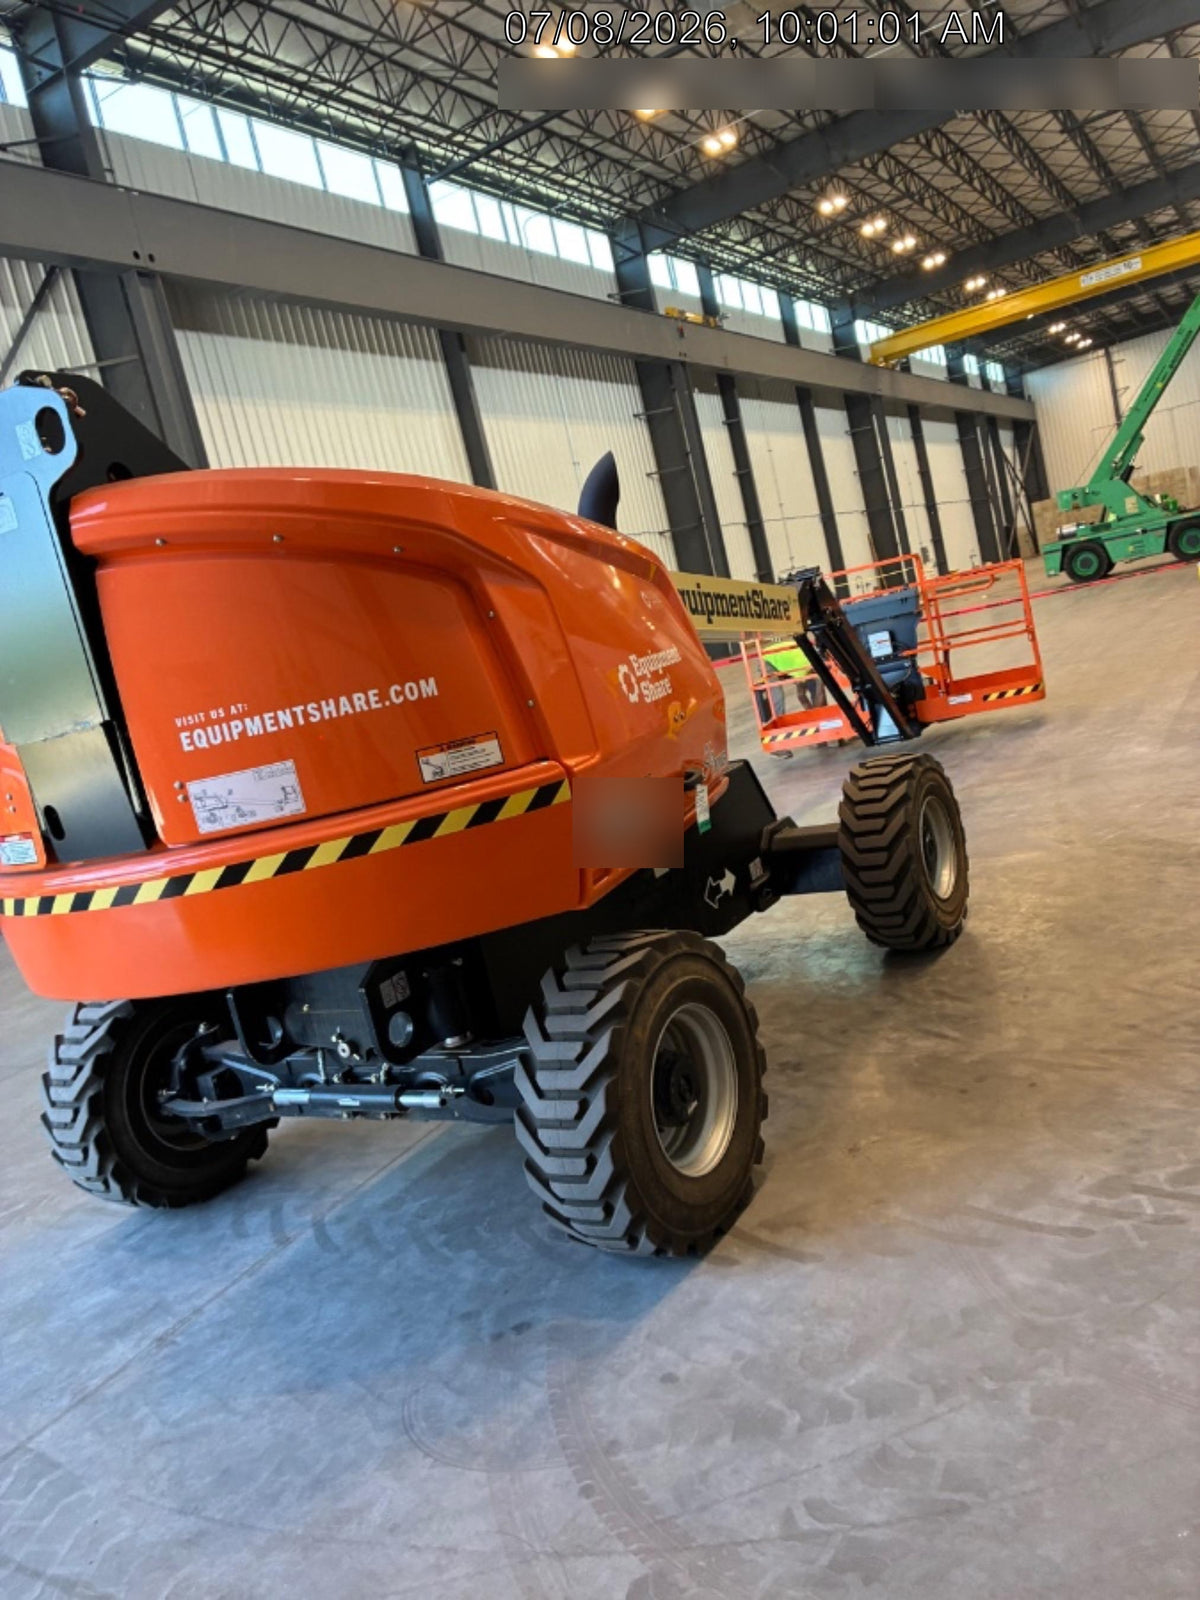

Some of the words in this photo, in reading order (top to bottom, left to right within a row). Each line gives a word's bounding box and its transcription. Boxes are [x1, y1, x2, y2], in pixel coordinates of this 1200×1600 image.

[628, 643, 682, 678] Equipment
[640, 677, 673, 703] Share
[175, 712, 206, 728] VISIT
[209, 707, 226, 719] US
[230, 703, 249, 715] AT:
[179, 677, 439, 752] EQUIPMENTSHARE.COM
